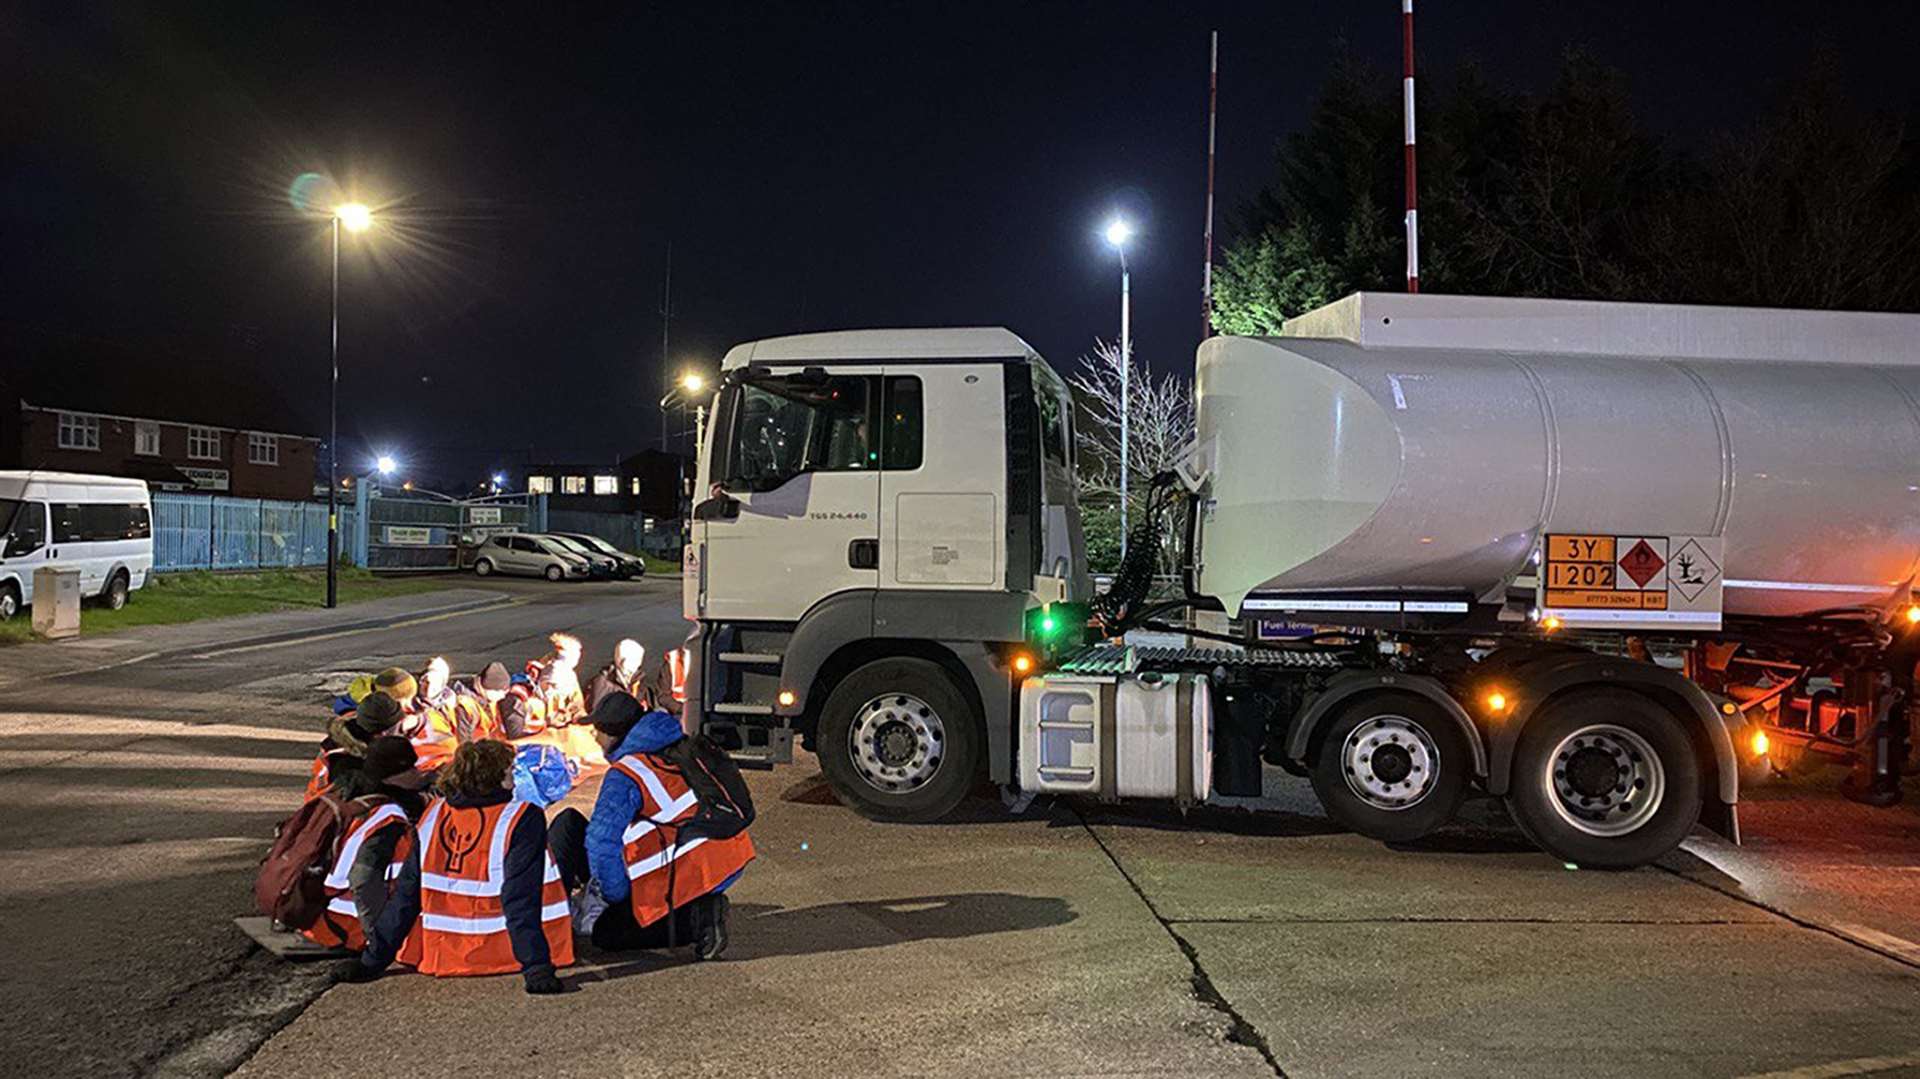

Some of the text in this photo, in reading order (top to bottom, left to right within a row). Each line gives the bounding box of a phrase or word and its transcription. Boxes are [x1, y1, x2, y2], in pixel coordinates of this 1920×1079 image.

[1568, 539, 1598, 559] 3Y
[1553, 565, 1614, 586] 1202
[1263, 620, 1285, 630] Fuel
